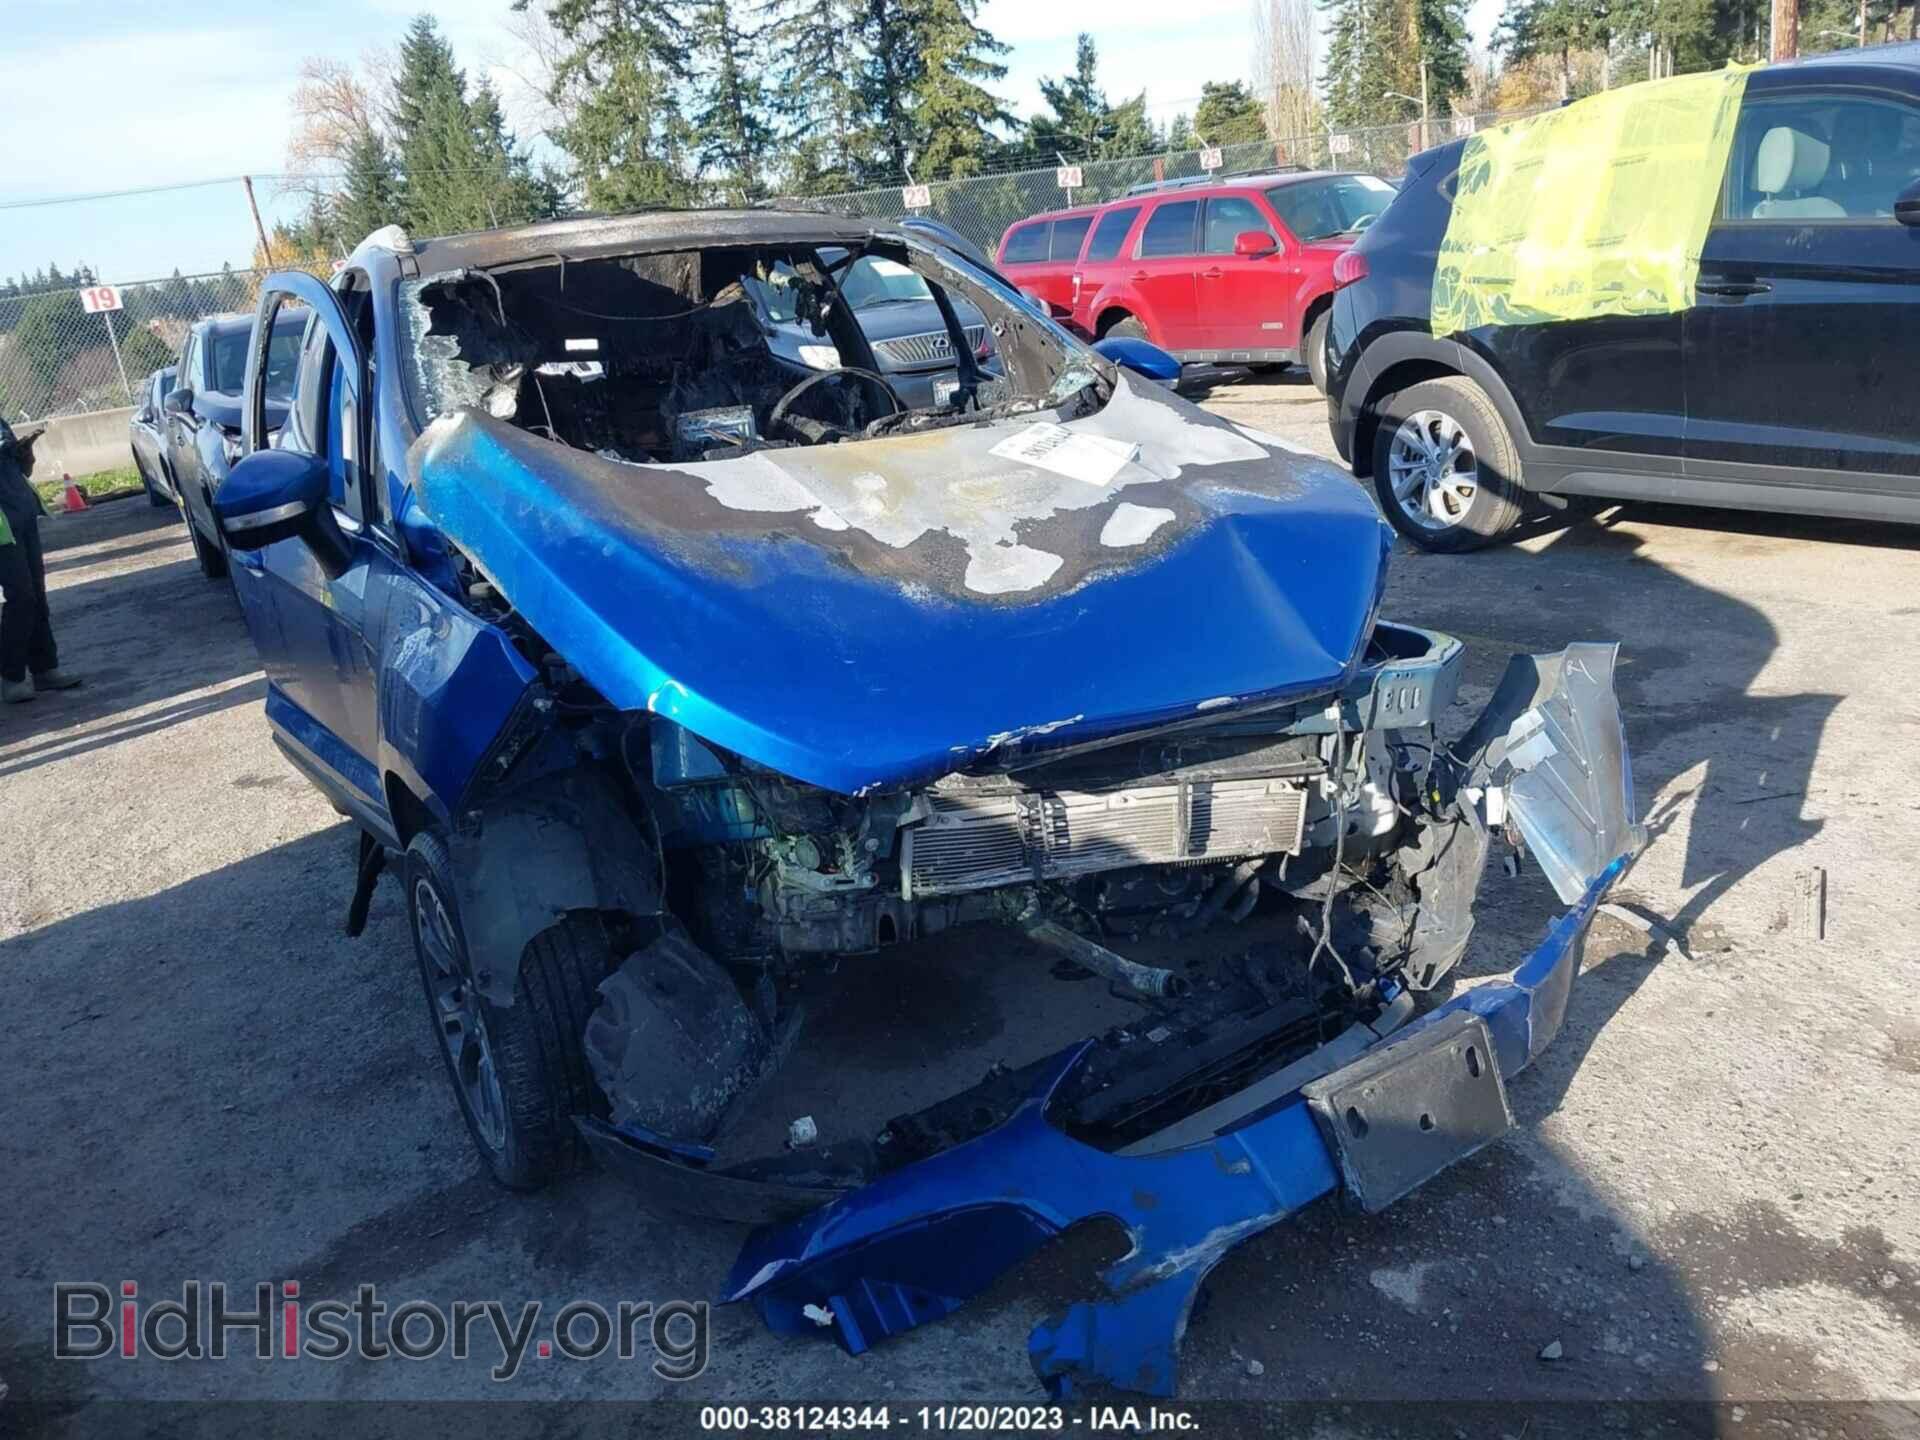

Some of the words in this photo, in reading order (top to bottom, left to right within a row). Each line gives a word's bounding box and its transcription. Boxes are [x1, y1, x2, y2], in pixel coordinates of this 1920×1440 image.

[1203, 150, 1220, 167] 25
[1060, 169, 1079, 185] 24
[906, 188, 927, 205] 23
[88, 287, 115, 310] 19
